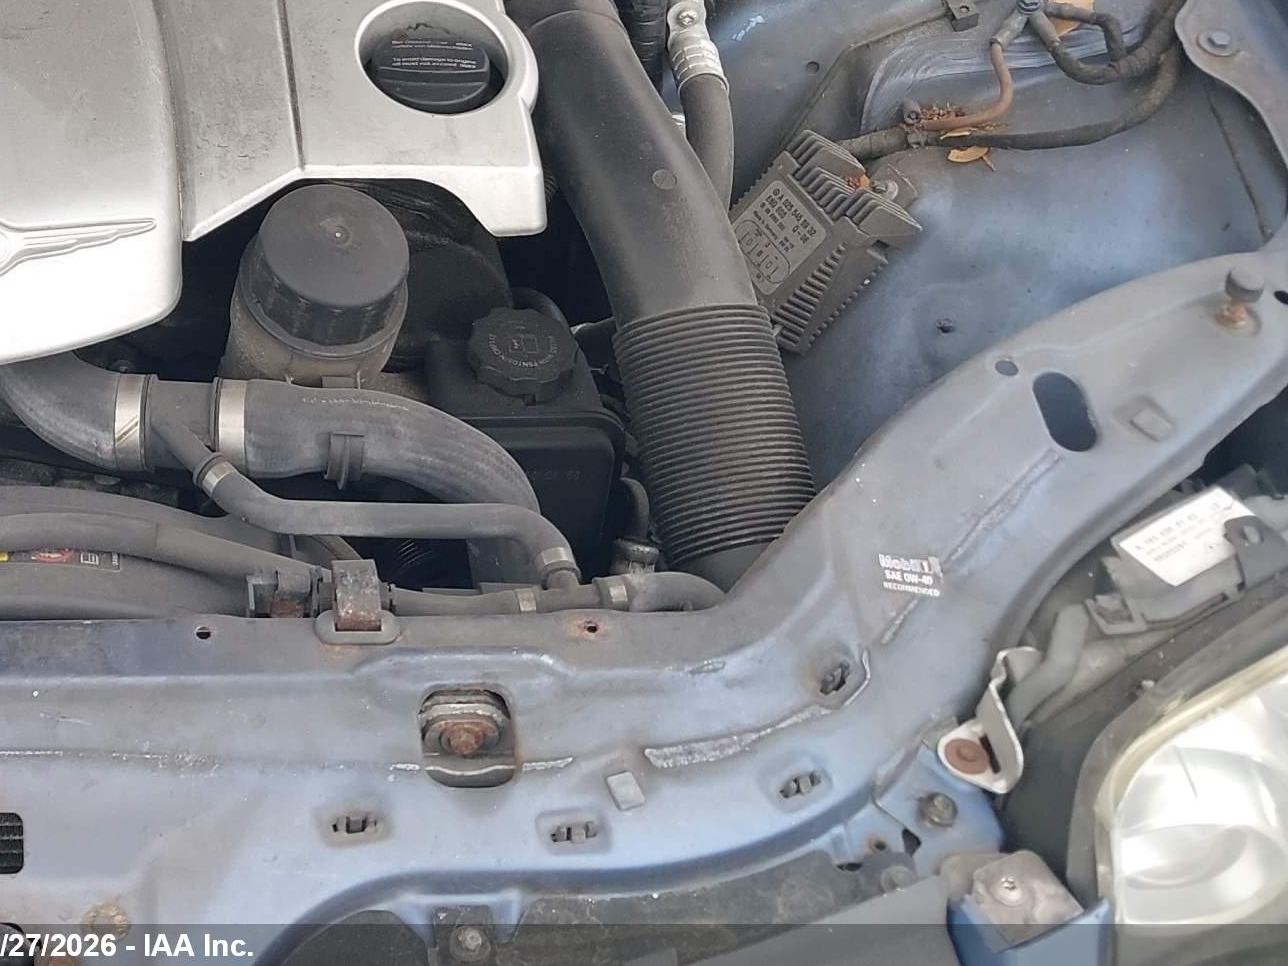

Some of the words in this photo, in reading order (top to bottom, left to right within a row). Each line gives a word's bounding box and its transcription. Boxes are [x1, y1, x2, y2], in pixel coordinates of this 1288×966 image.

[878, 553, 921, 572] Mobil
[884, 569, 903, 581] SAE
[903, 573, 934, 586] 0W-40
[882, 581, 940, 597] RECOMMENDED
